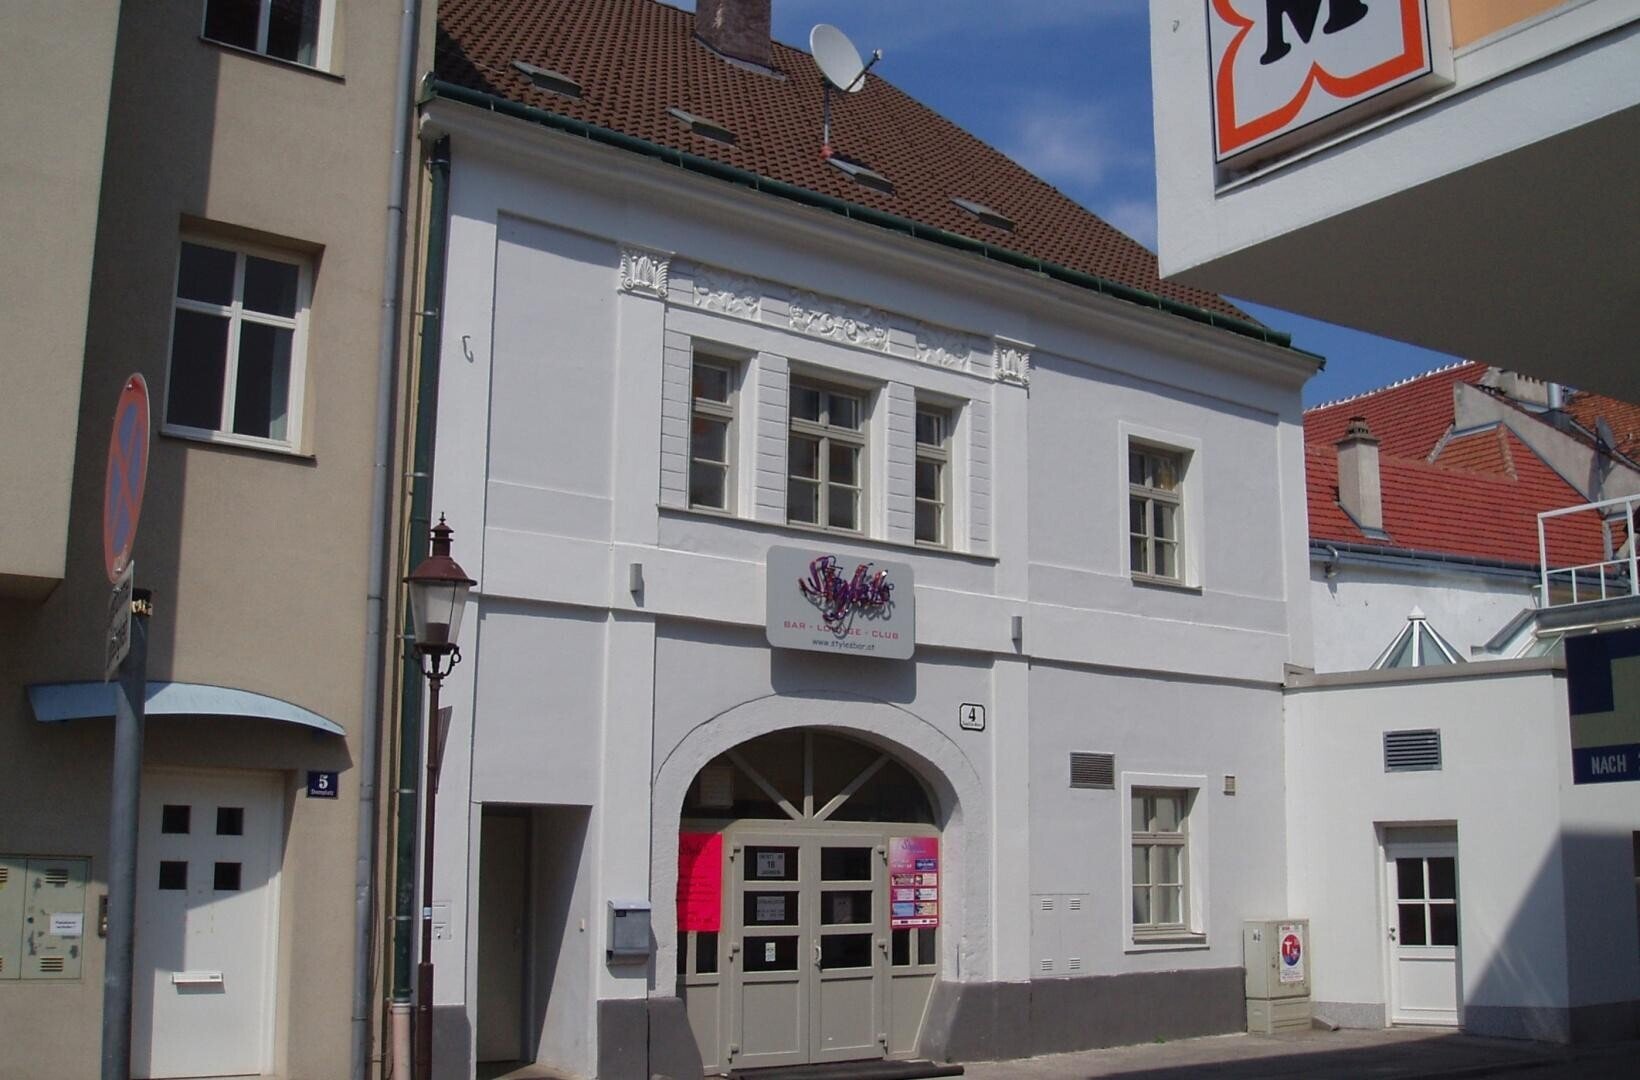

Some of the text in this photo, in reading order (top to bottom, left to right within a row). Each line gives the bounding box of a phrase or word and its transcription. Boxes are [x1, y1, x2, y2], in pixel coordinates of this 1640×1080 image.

[784, 620, 806, 630] BAR
[872, 630, 899, 640] CLUB
[968, 706, 976, 721] 4
[1591, 753, 1627, 775] NACH
[319, 774, 329, 789] 5
